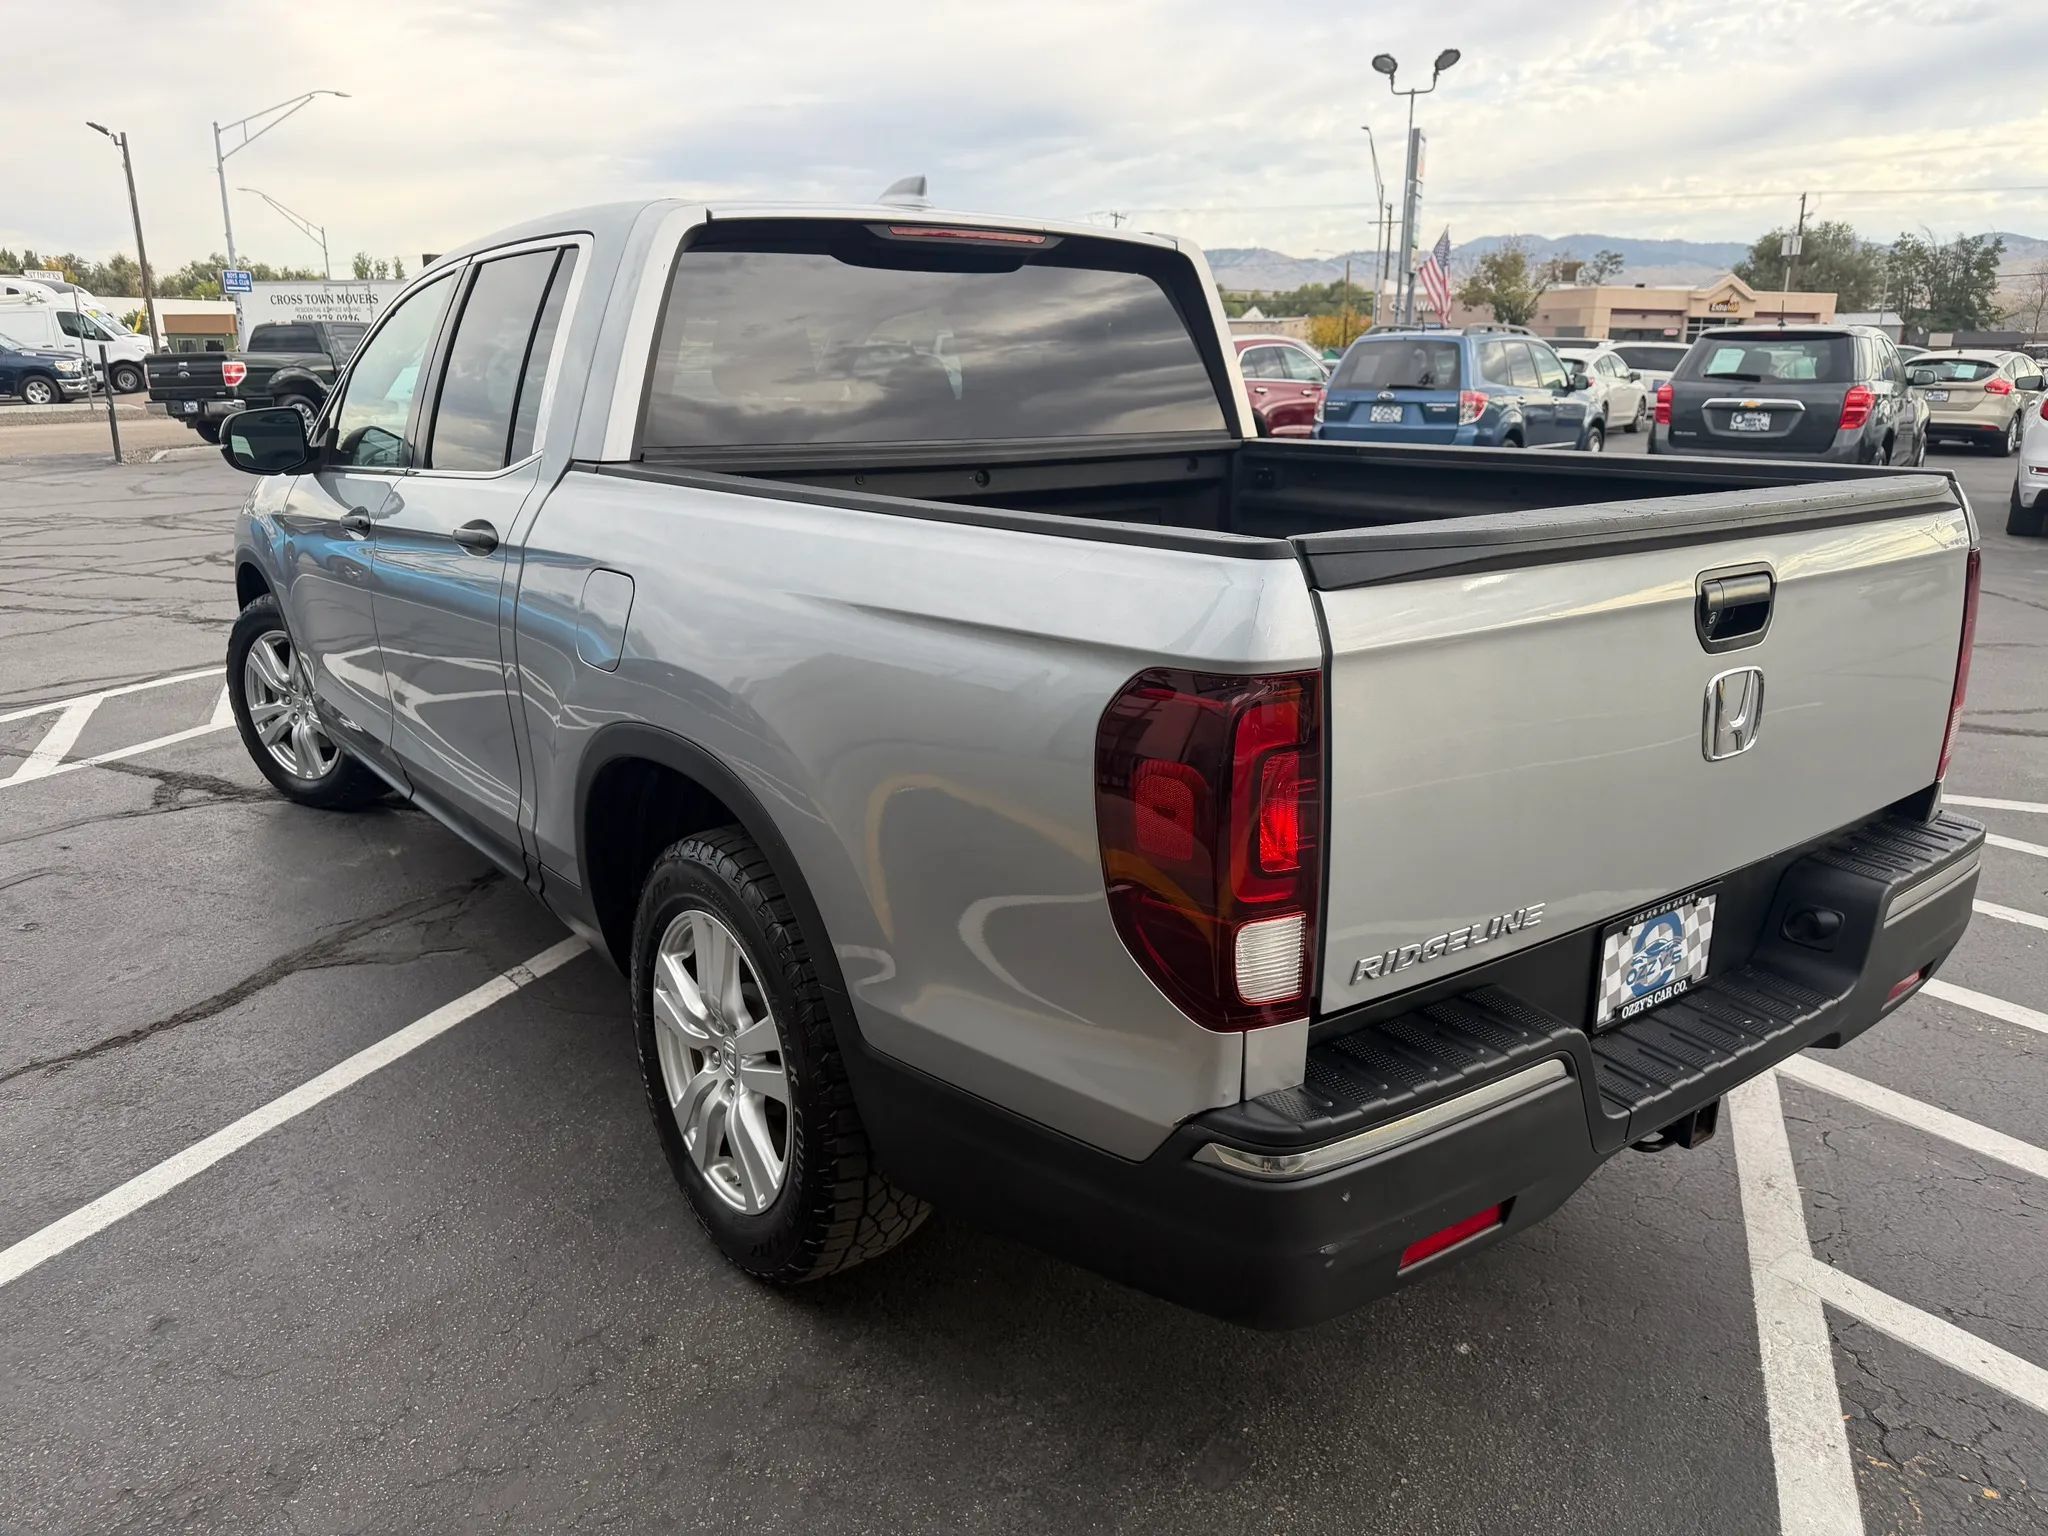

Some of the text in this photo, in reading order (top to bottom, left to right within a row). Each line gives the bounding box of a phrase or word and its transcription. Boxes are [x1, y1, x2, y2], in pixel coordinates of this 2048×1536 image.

[270, 293, 379, 305] CROSS TOWN MOVERS
[1350, 902, 1547, 985] RIDGELINE
[1621, 980, 1688, 1019] OZZY'S CAR CO.
